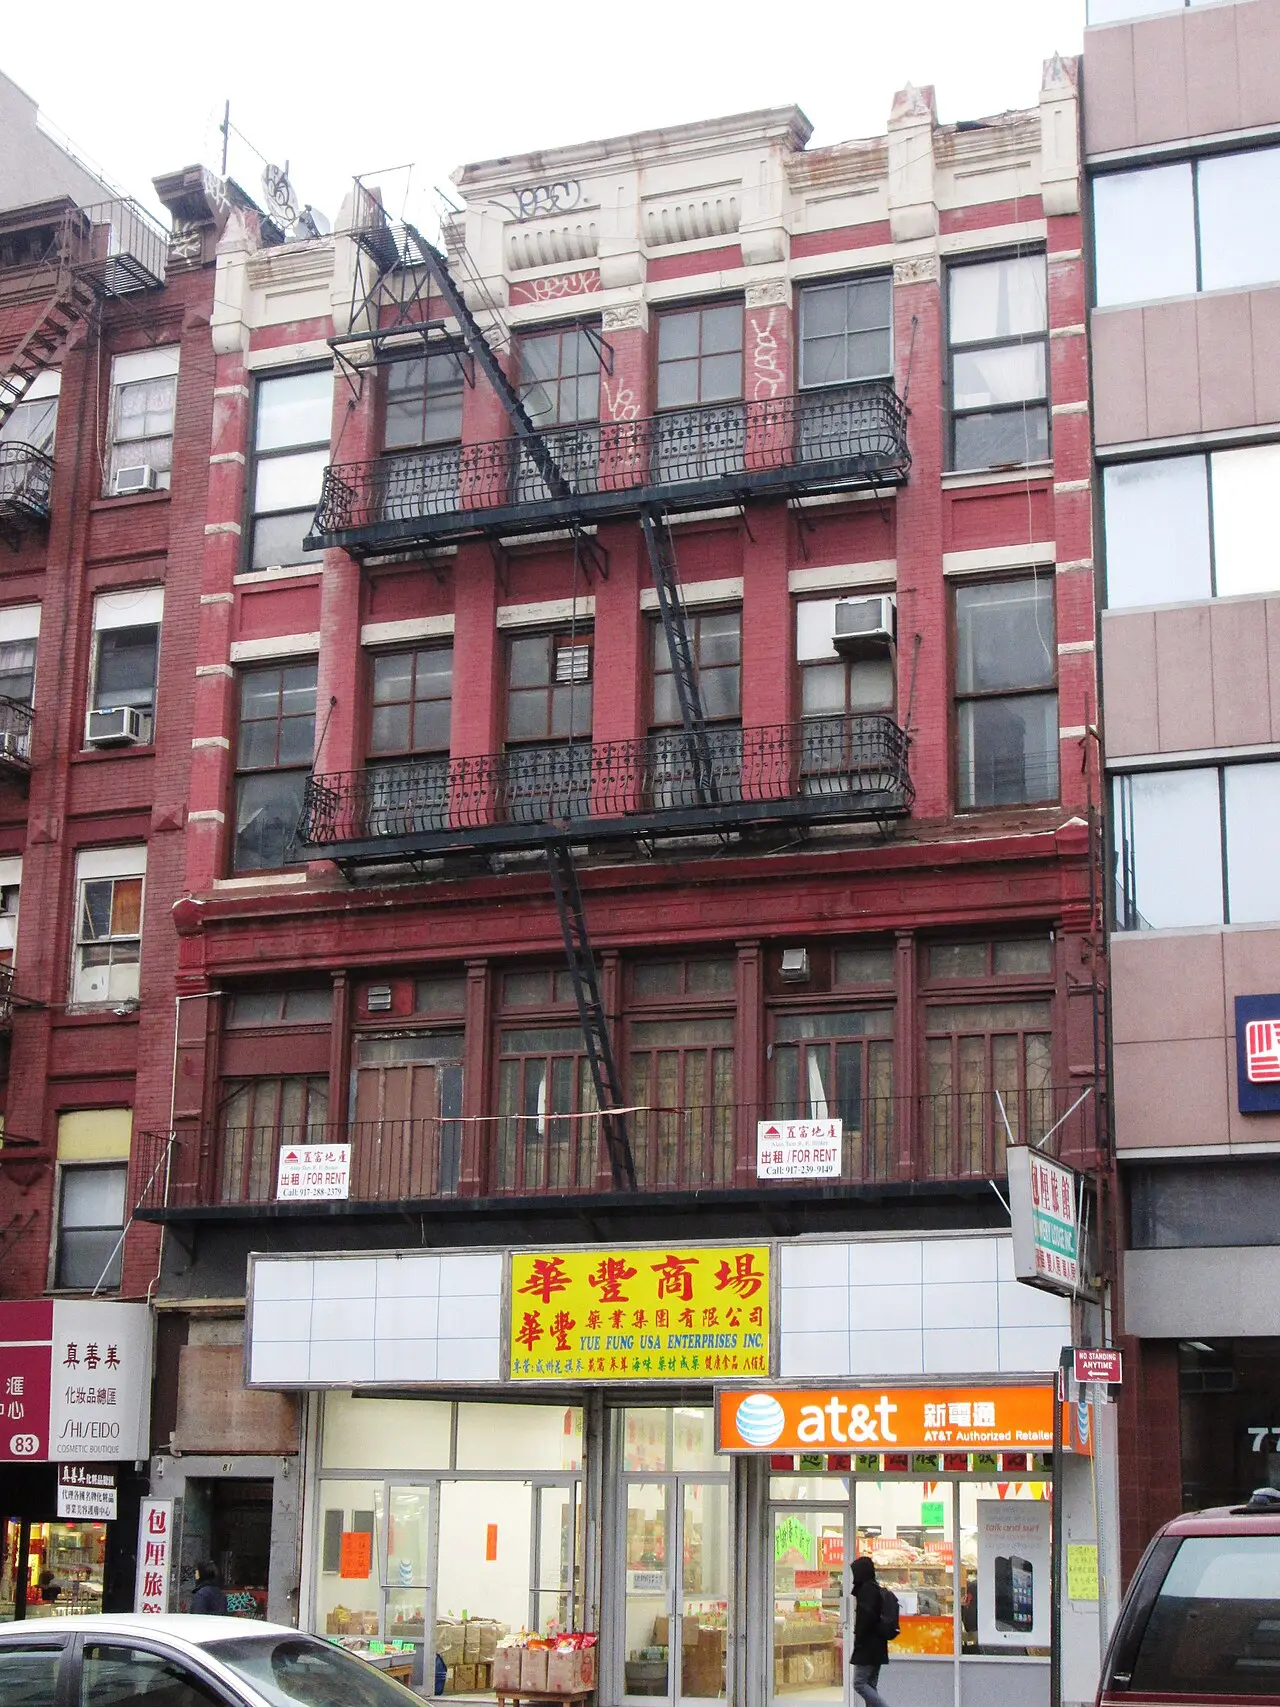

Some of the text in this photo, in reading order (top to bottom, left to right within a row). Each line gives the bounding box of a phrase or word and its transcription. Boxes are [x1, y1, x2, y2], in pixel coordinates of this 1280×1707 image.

[761, 1151, 783, 1164] 出租
[813, 1148, 837, 1162] RENT
[281, 1173, 300, 1186] 出租
[325, 1172, 346, 1185] RENT
[517, 1252, 765, 1304] 華豐商場
[515, 1310, 576, 1352] 華豐
[579, 1333, 764, 1351] YUE FUNG USA ENTERPRISES INC.
[63, 1342, 121, 1370] 真善美
[1079, 1352, 1117, 1361] NO STANDING
[1083, 1361, 1113, 1370] ANYTIME
[797, 1396, 898, 1443] at&t
[924, 1401, 996, 1428] 新電通
[59, 1419, 120, 1439] SHISEIDO
[924, 1429, 1054, 1442] AT&T Authorized Retailer
[15, 1437, 34, 1452] 83
[57, 1444, 120, 1454] COSMETIC BOUTIQUE
[222, 1463, 233, 1472] 81
